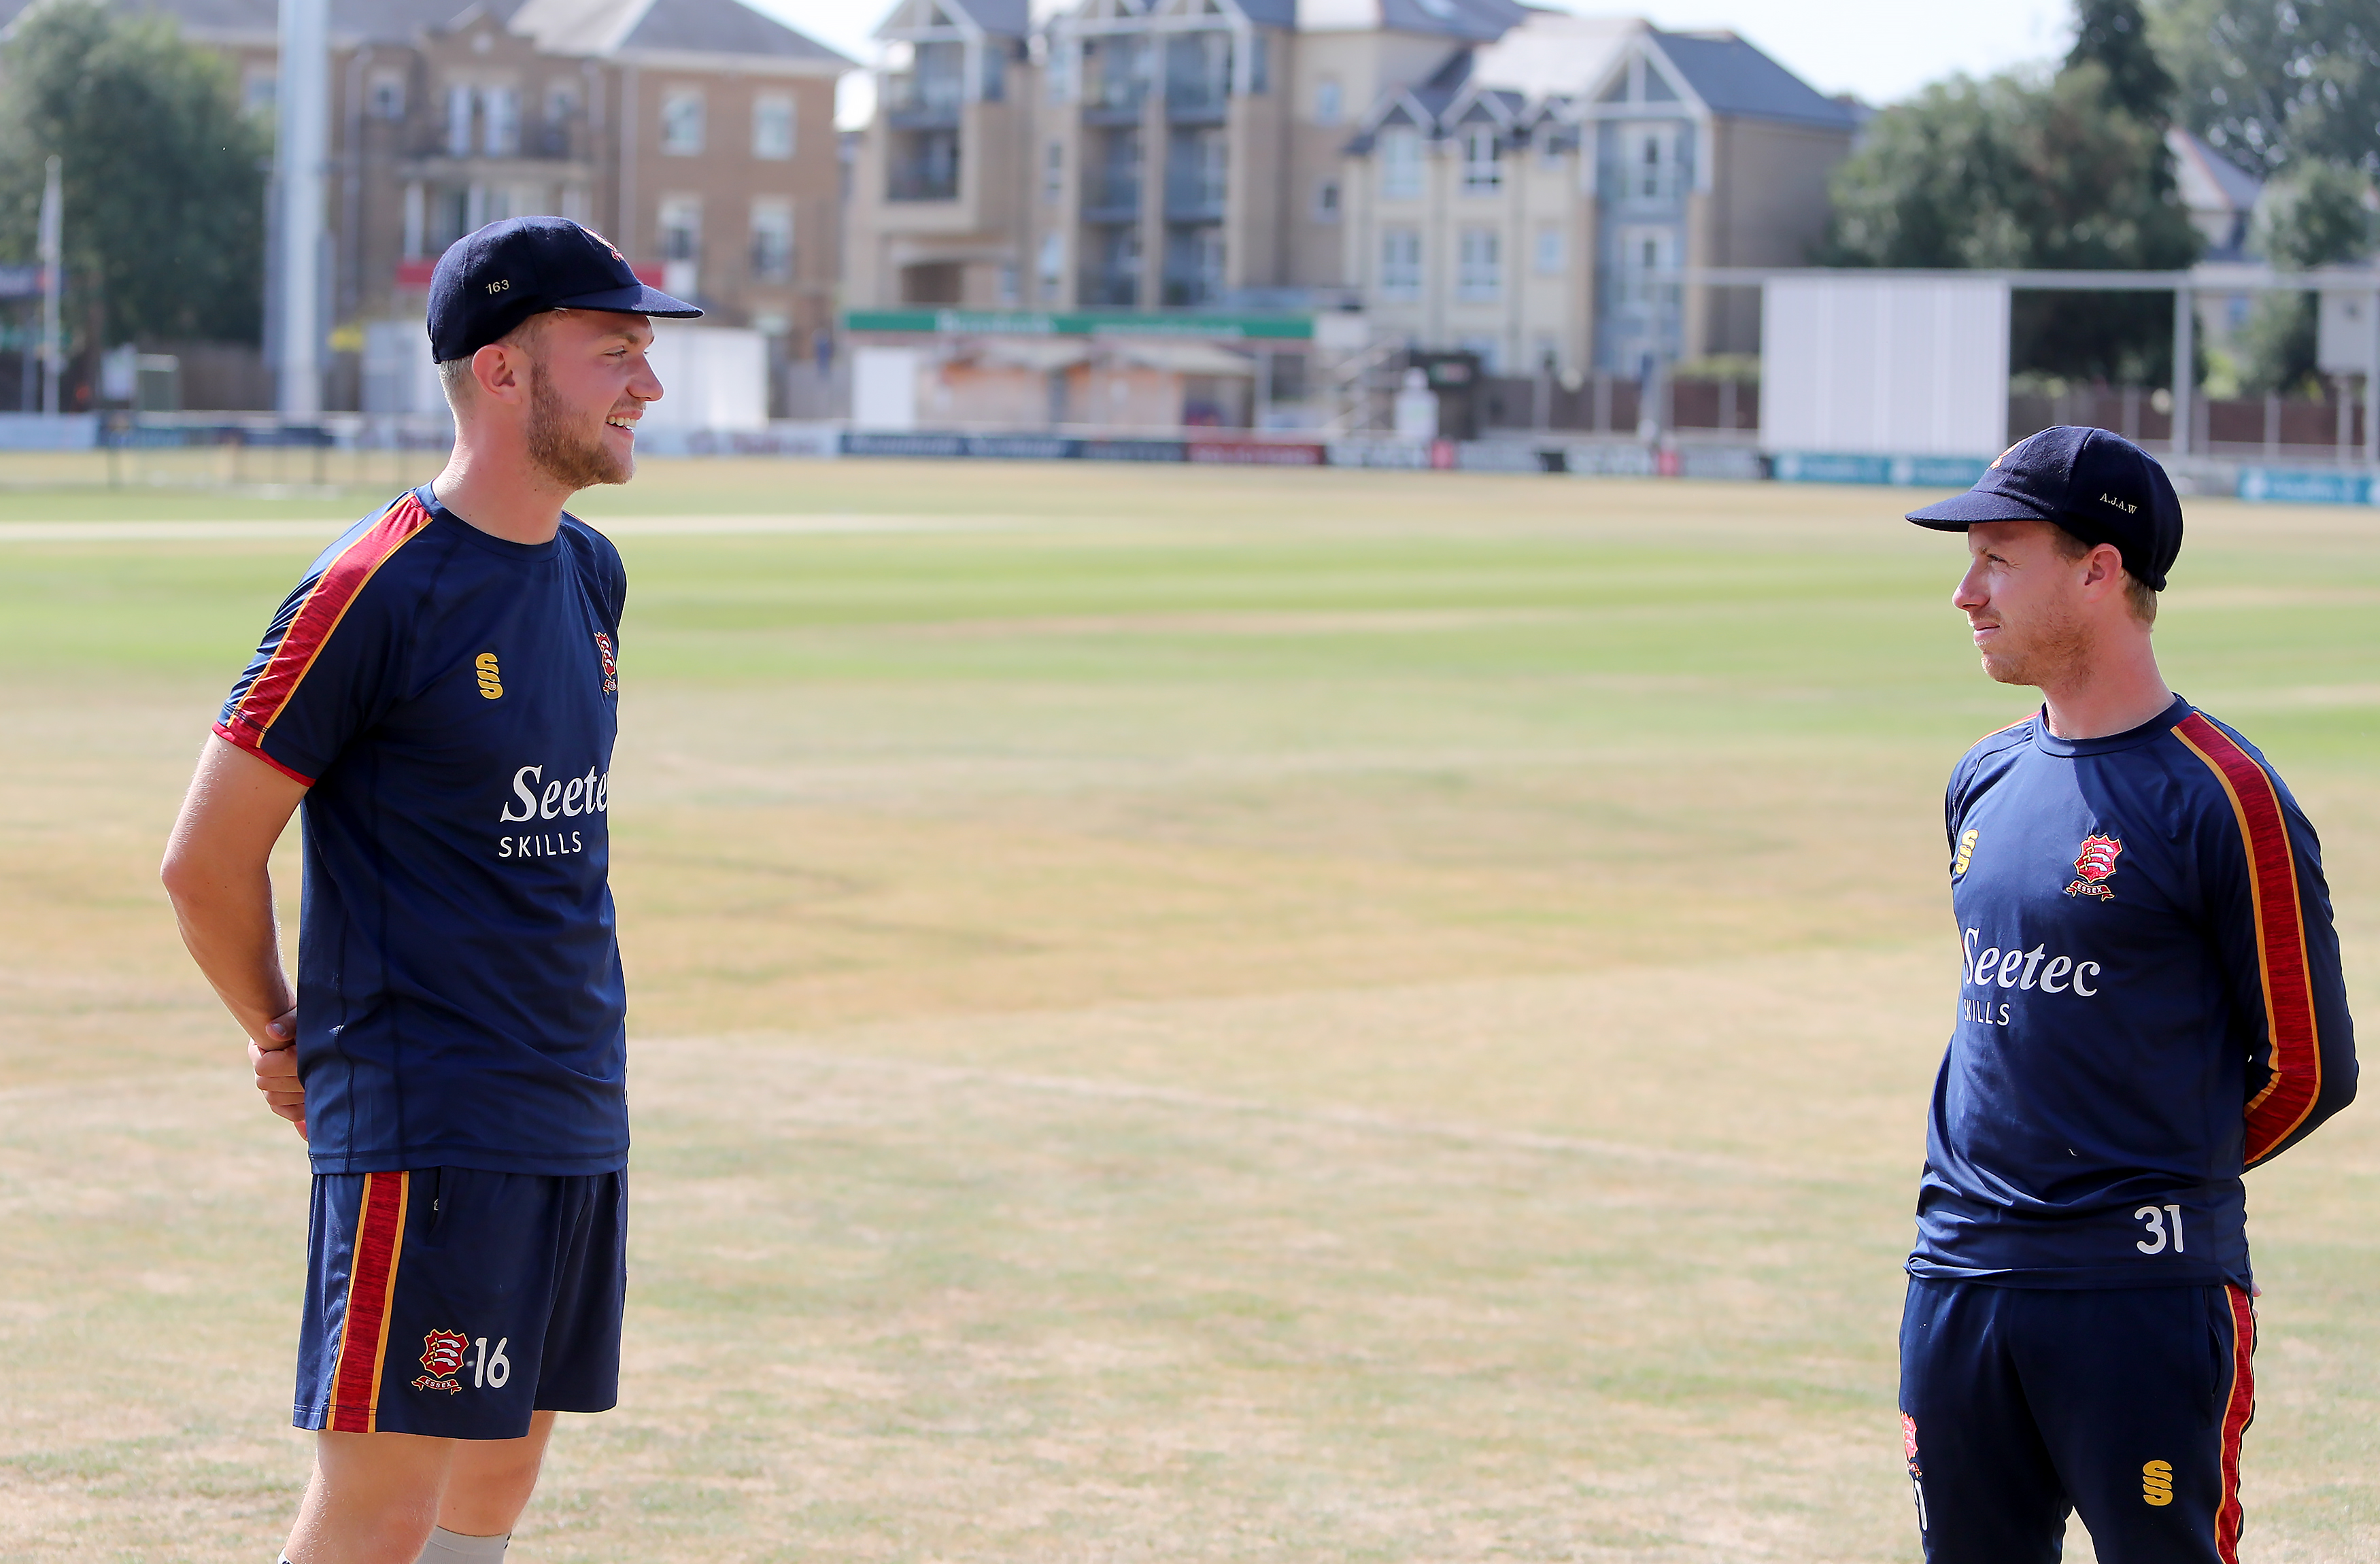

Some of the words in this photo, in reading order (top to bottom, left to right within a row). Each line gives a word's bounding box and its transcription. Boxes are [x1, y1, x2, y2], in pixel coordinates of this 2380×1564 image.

[486, 279, 509, 294] 163
[500, 764, 609, 822] Seete
[498, 831, 581, 857] SKILLS
[2077, 883, 2102, 893] ESSEX
[1963, 927, 2101, 997] Seetec
[2135, 1204, 2184, 1255] 31
[475, 1337, 510, 1389] 16
[424, 1379, 452, 1388] ESSEX
